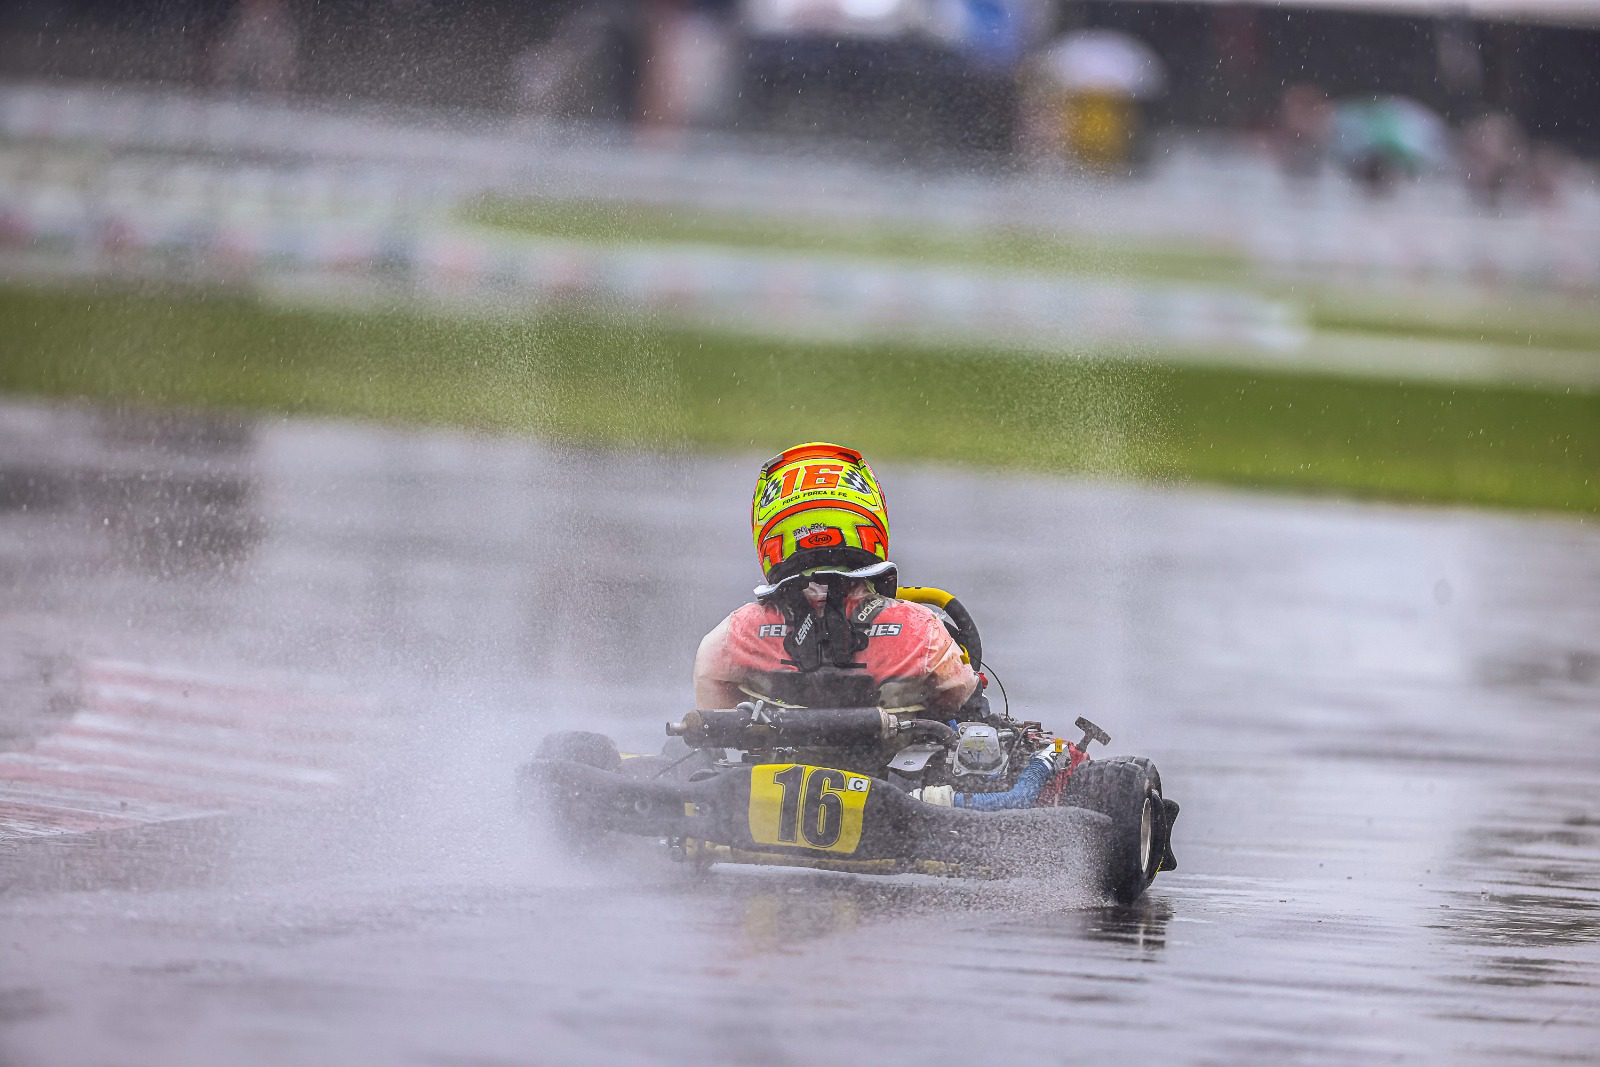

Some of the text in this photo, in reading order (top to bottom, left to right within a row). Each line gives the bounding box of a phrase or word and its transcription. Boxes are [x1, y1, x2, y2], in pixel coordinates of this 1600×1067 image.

[780, 464, 844, 500] 16
[759, 624, 787, 637] FEL
[795, 613, 813, 646] LEATT
[853, 779, 864, 791] C
[773, 764, 847, 849] 16
